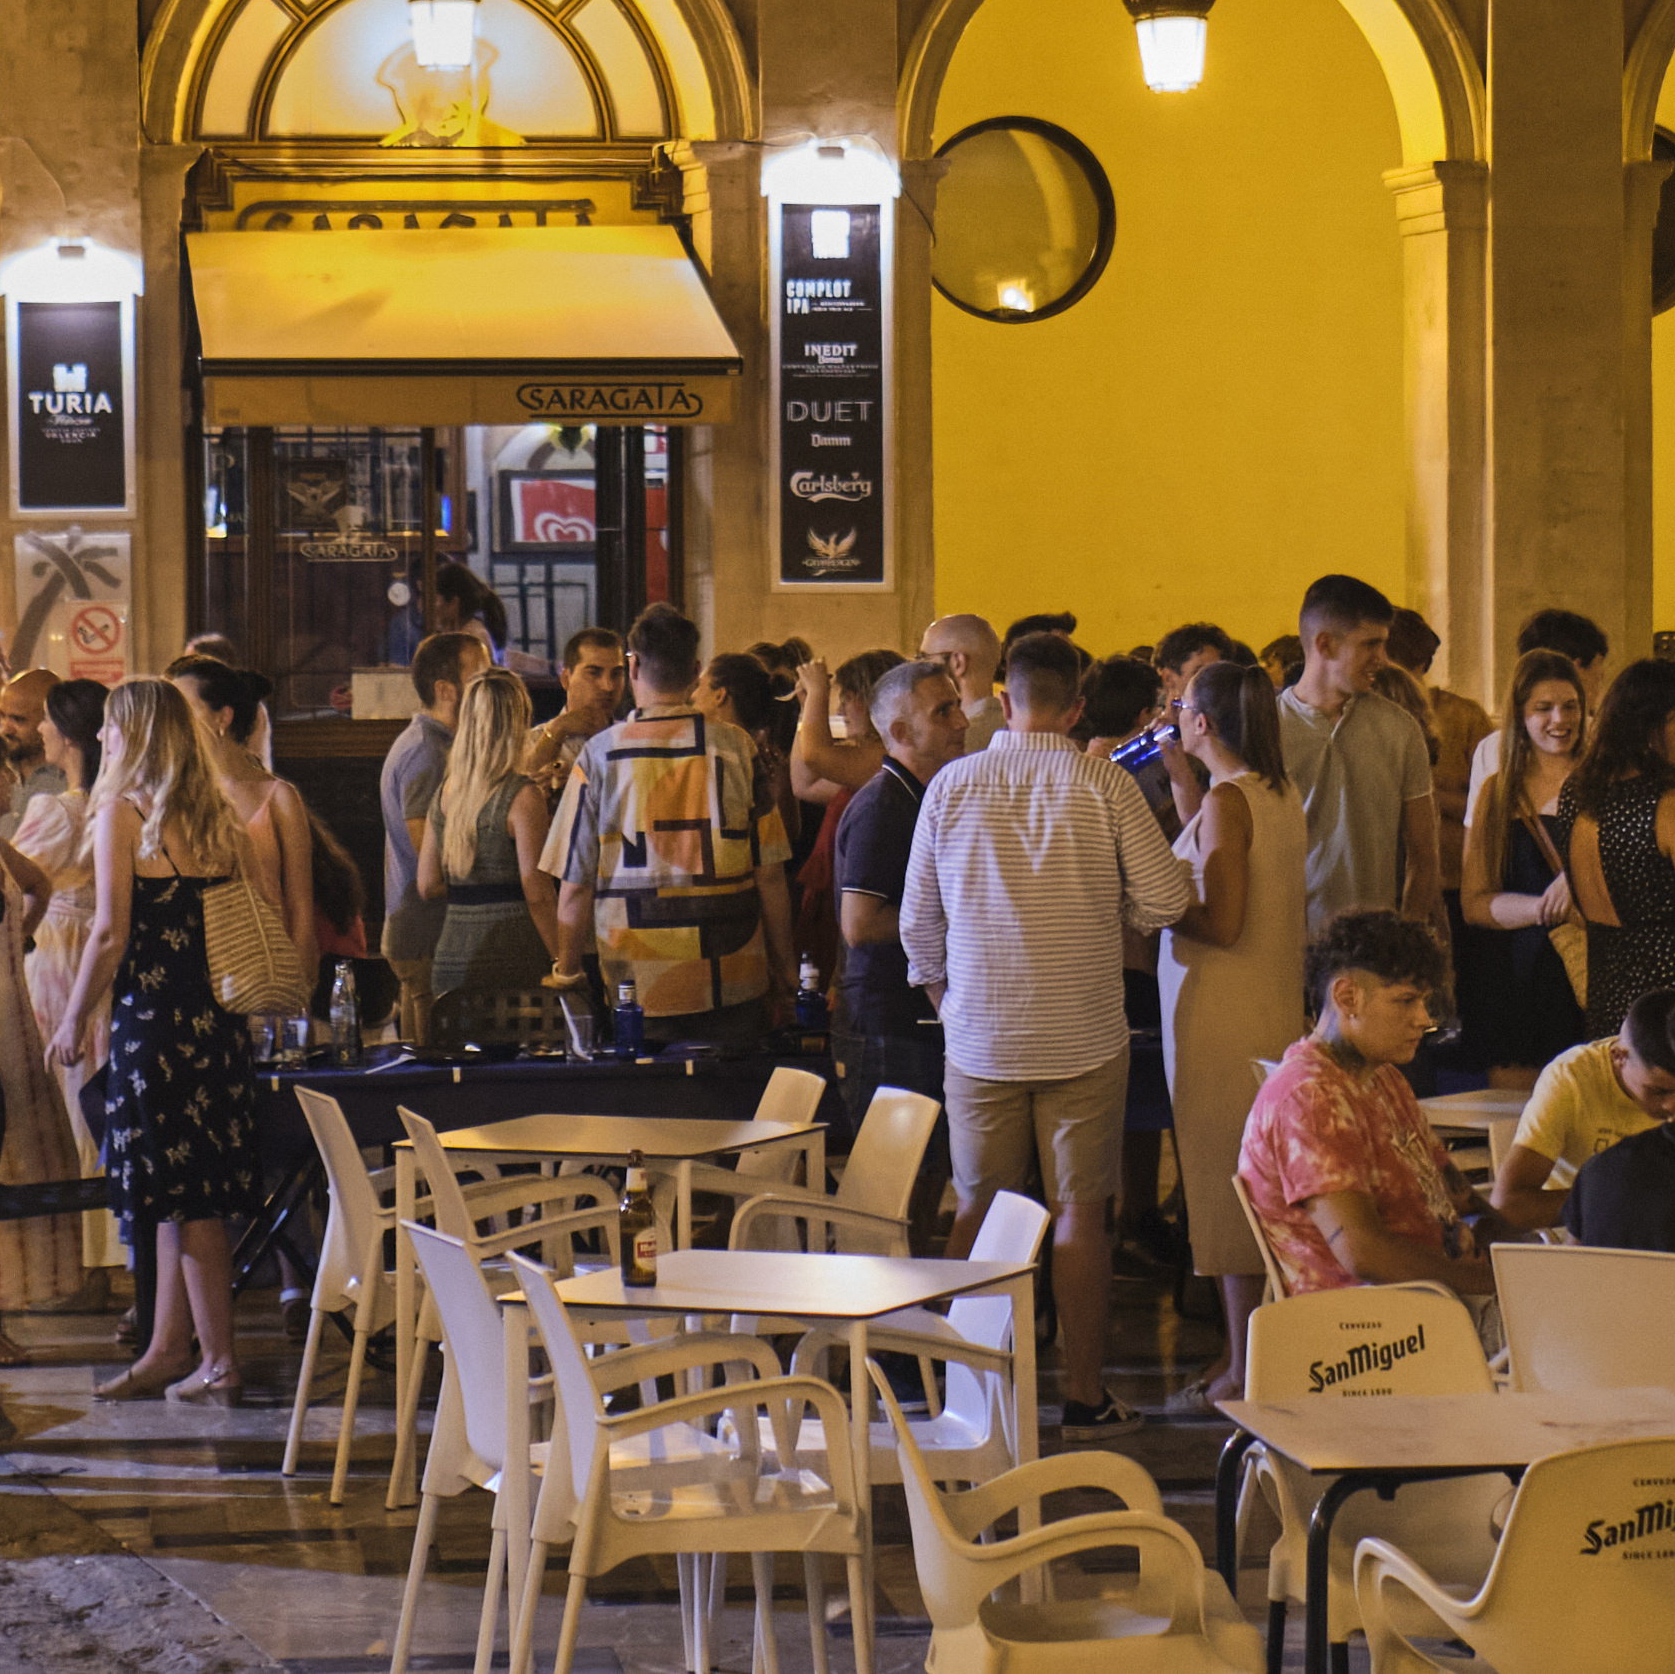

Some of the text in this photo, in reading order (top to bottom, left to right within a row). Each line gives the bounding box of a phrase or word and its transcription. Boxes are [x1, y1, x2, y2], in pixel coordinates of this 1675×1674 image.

[786, 279, 852, 298] COMPLOT
[786, 298, 810, 314] IPA
[804, 344, 858, 357] INEDIT
[28, 392, 113, 414] TURIA
[529, 386, 691, 411] SARAGATA
[786, 401, 874, 423] DUET
[811, 433, 852, 447] Damm
[790, 471, 873, 500] Carlsberg
[304, 543, 393, 558] SARAGATA
